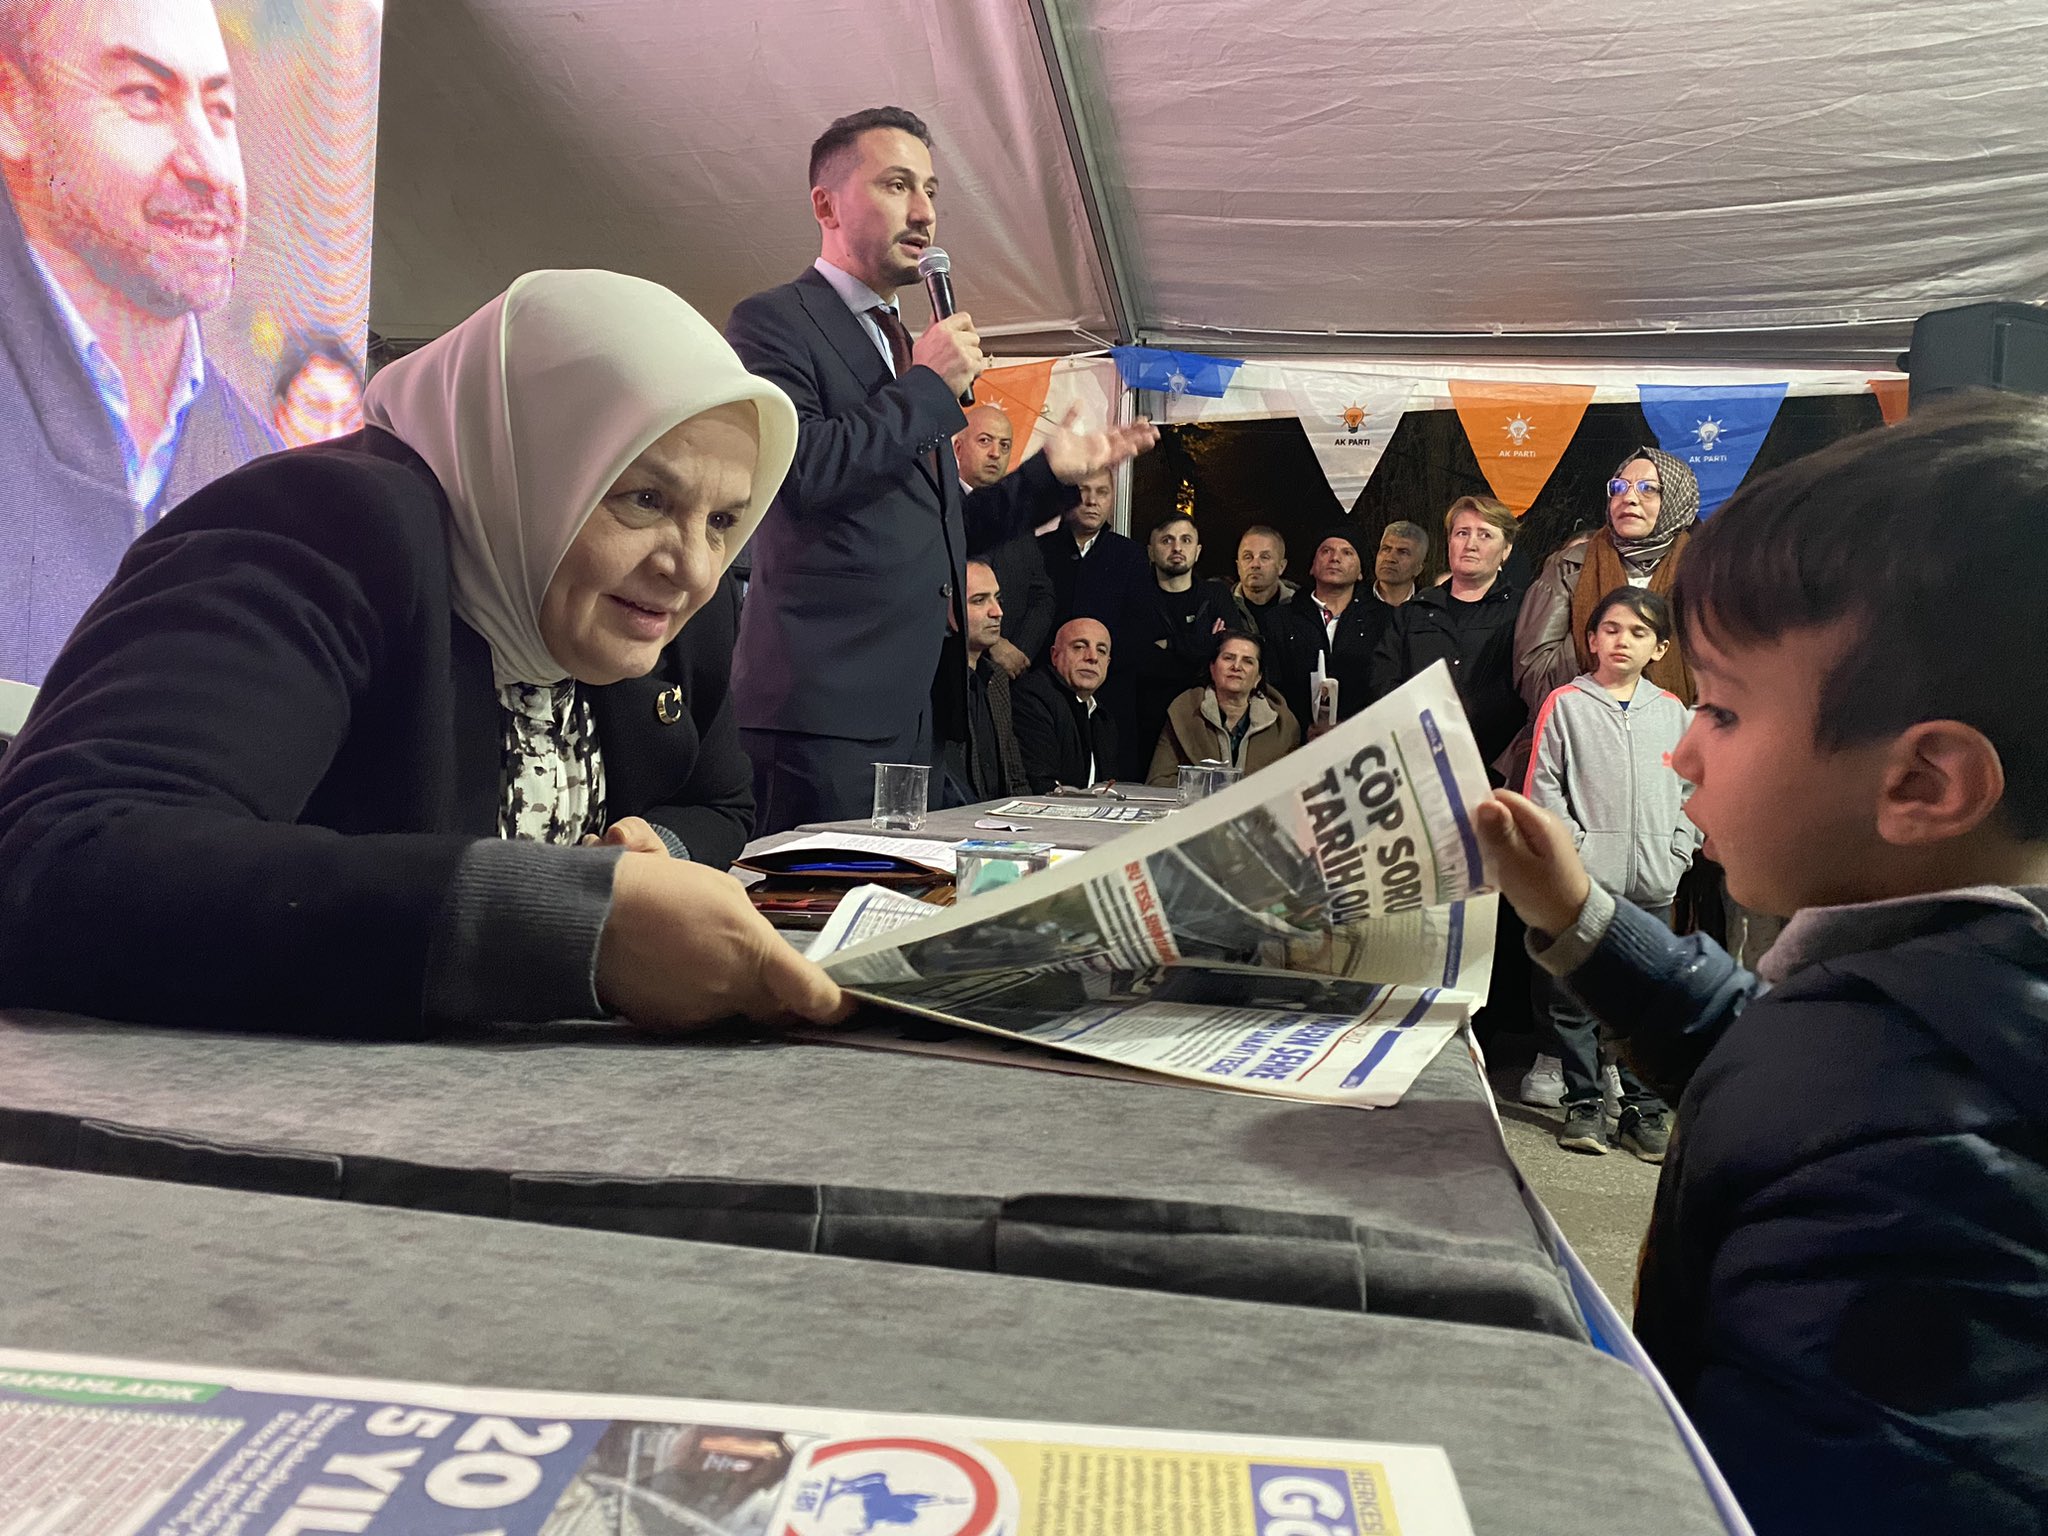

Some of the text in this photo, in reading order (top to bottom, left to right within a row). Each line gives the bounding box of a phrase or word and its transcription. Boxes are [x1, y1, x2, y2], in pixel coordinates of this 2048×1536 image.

[1334, 438, 1347, 446] AK
[1498, 450, 1512, 458] AK
[1689, 455, 1702, 463] AK
[1344, 745, 1404, 831] ÇÖP
[1302, 767, 1367, 891] TARİH
[1244, 1046, 1314, 1080] ŞEHRE
[264, 1405, 457, 1536] 5 YIL
[424, 1416, 573, 1510] 20
